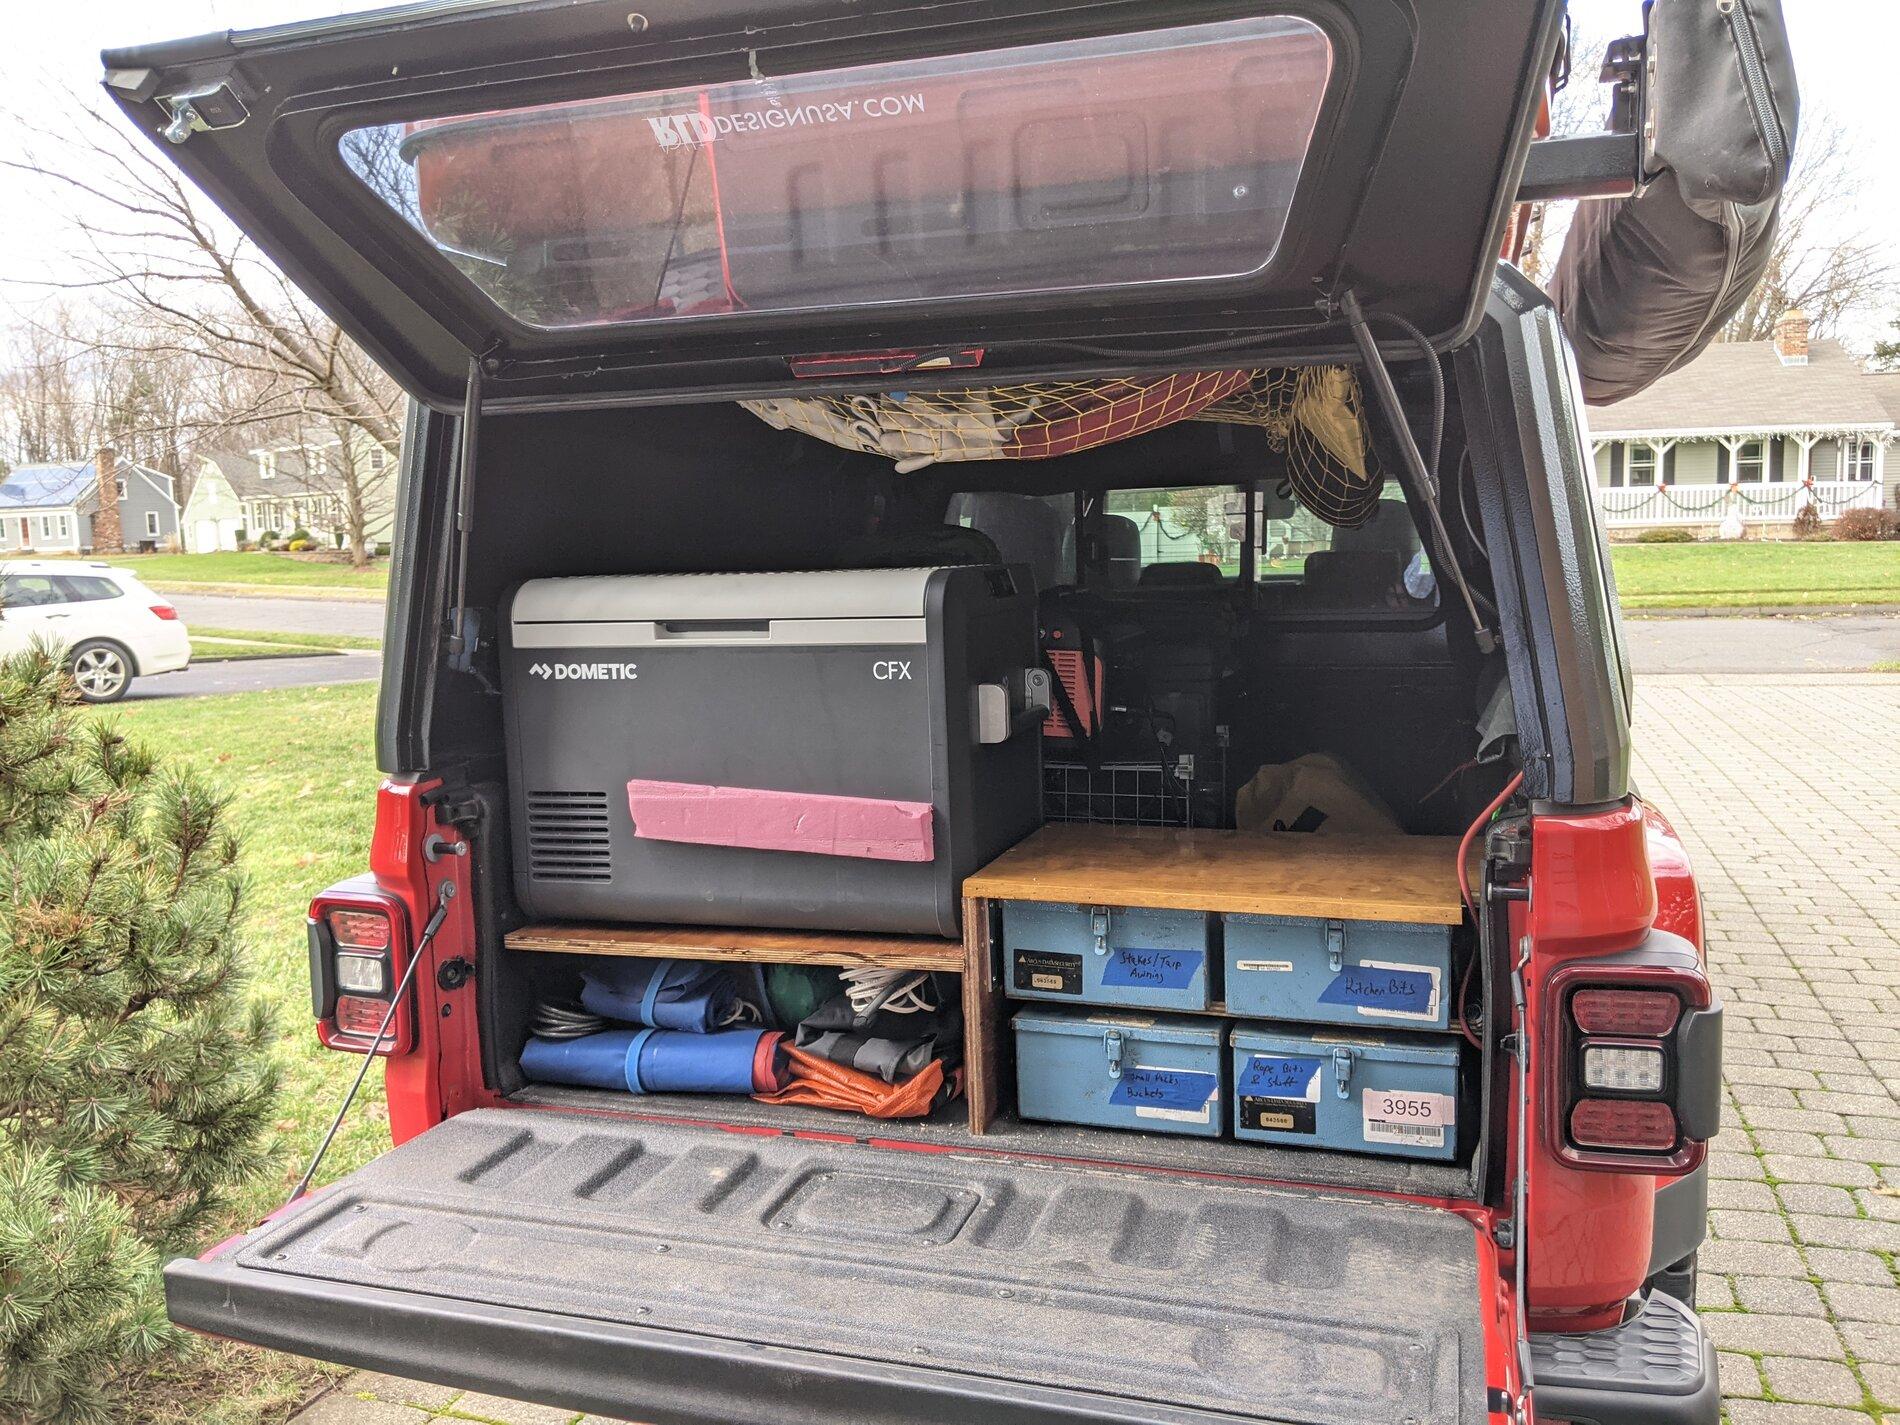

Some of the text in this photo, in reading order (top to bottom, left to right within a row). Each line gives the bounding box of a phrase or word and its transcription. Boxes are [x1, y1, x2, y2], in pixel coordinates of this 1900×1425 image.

[554, 663, 638, 680] DOMETIC
[872, 661, 912, 680] CFX
[1130, 967, 1163, 984] Awning
[1345, 977, 1416, 996] Kitchen Bits
[1253, 1059, 1304, 1076] Rope Bits
[1383, 1098, 1431, 1118] 3955
